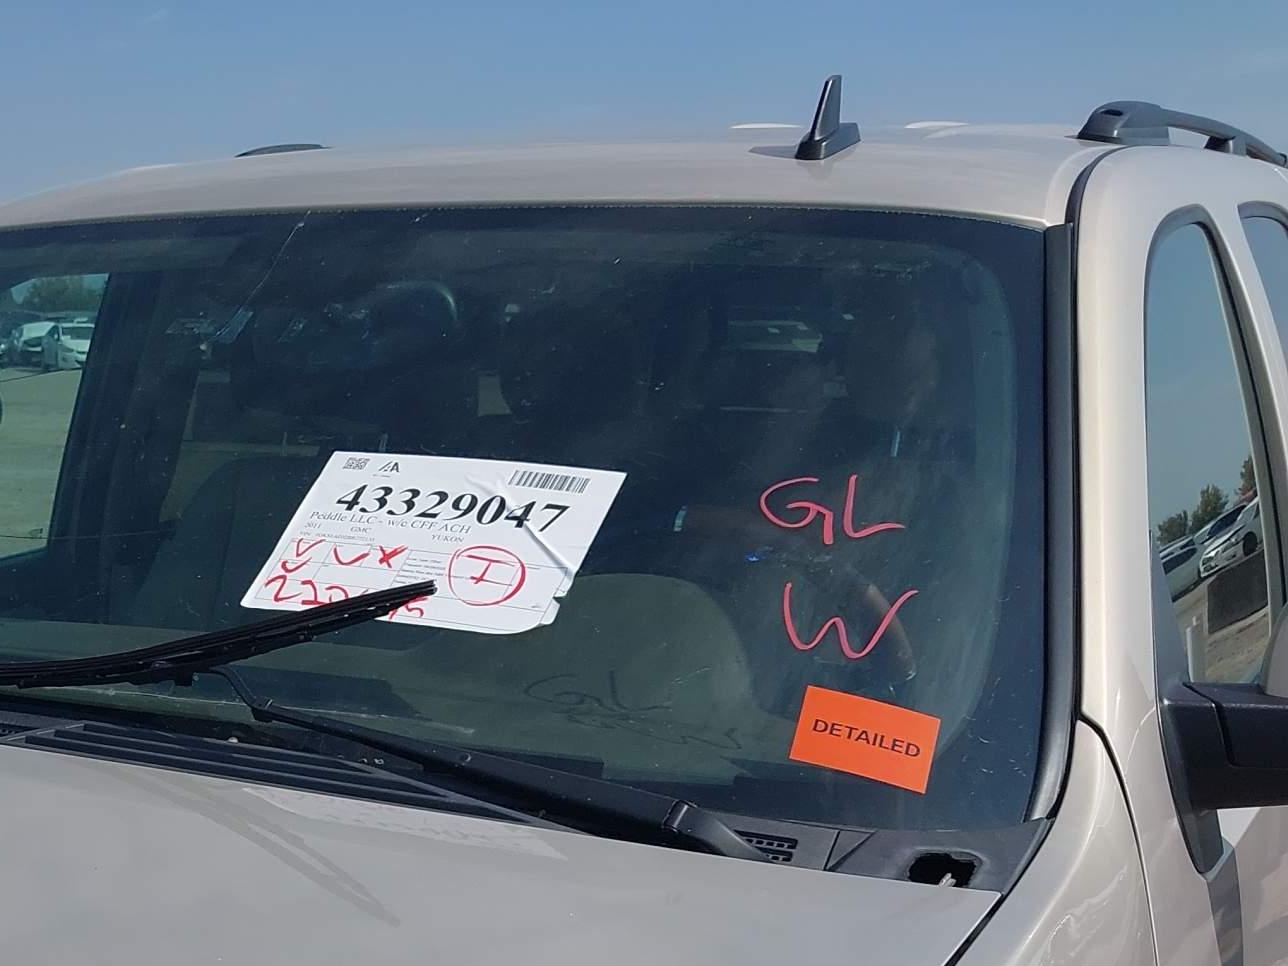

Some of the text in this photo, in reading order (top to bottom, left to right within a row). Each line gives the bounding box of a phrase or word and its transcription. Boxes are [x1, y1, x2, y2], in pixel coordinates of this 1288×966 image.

[310, 511, 348, 522] Peddle
[349, 514, 377, 525] LLC
[439, 523, 472, 535] ACH
[336, 483, 570, 534] 43329047
[760, 474, 906, 545] GL
[431, 534, 465, 543] YUKON
[783, 581, 920, 660] W
[812, 718, 921, 759] DETAILED
